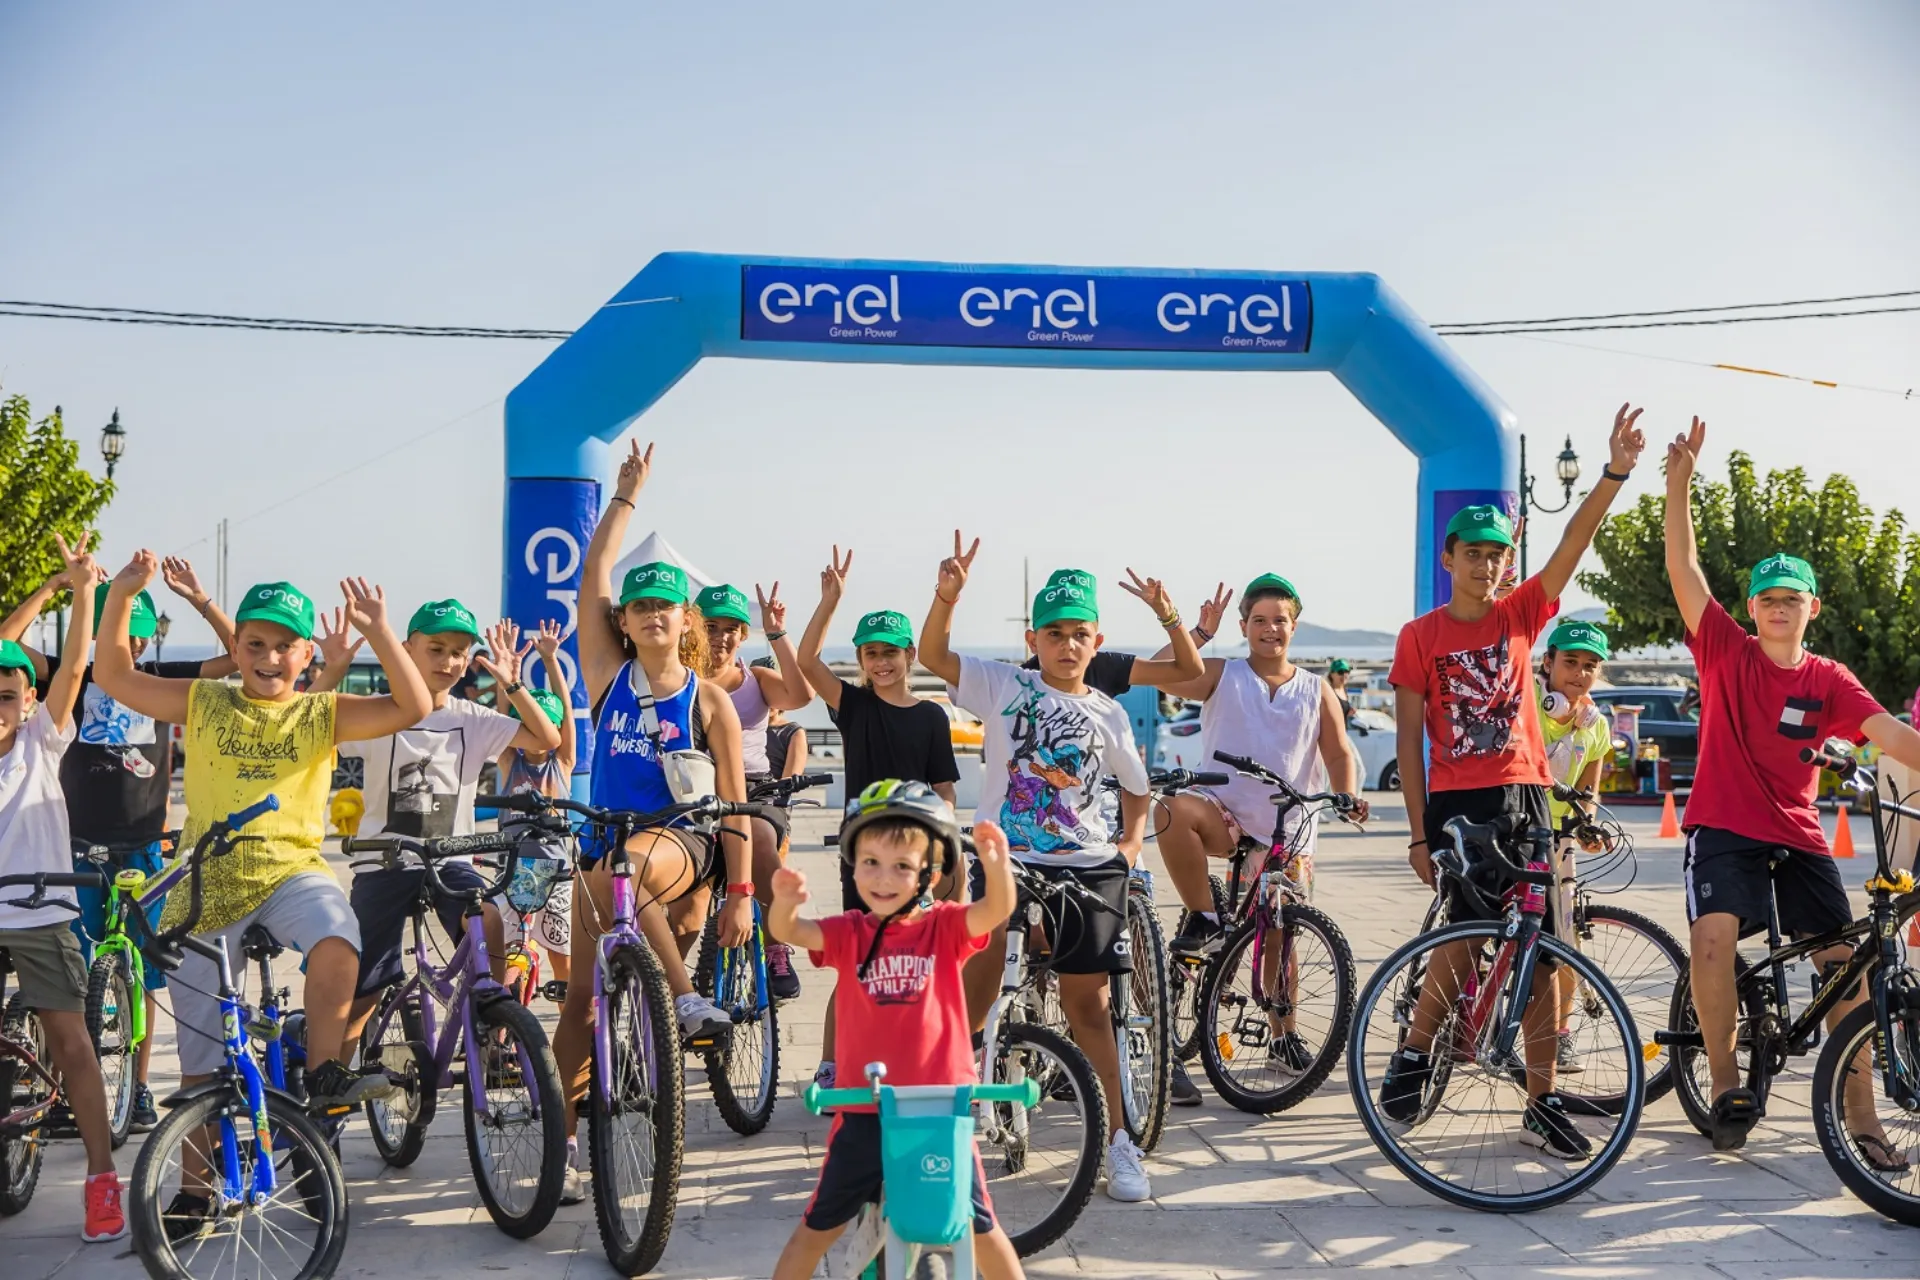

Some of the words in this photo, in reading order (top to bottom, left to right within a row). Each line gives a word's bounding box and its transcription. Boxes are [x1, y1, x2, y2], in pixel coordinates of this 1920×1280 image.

[758, 274, 902, 325] enel
[958, 279, 1100, 330] enel
[1156, 284, 1294, 335] enel
[829, 326, 862, 338] Green
[865, 326, 898, 339] Power
[1027, 329, 1059, 342] Green
[1061, 330, 1095, 342] Power
[1221, 335, 1253, 347] Green
[1255, 337, 1288, 348] Power
[1760, 560, 1799, 574] enel
[635, 570, 677, 584] enel
[1058, 575, 1091, 589] enel
[258, 589, 304, 612] enel
[712, 591, 744, 606] enel
[1045, 587, 1085, 602] enel
[434, 606, 472, 624] enel
[868, 615, 901, 628] enel
[1569, 628, 1601, 643] enel
[215, 726, 299, 762] Yourself
[1823, 1101, 1847, 1160] KENDA
